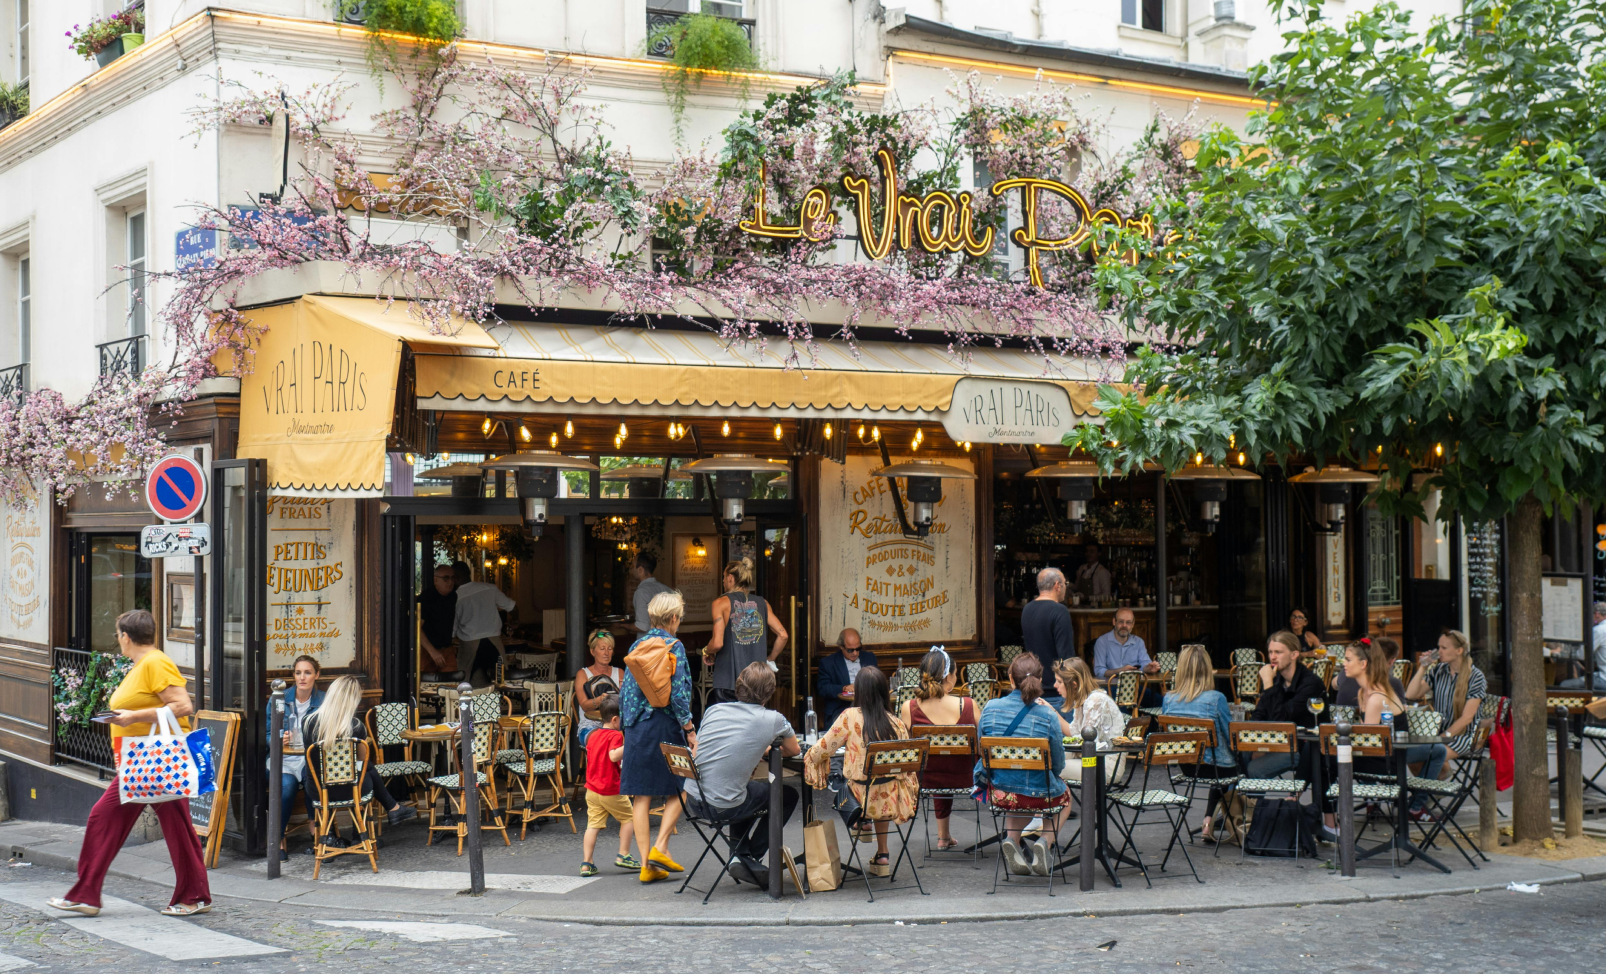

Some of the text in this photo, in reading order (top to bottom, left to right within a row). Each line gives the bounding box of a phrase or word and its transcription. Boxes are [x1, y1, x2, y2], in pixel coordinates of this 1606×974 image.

[738, 159, 839, 243] Le
[841, 147, 995, 260] Vrai
[263, 340, 368, 415] VRAI PARIS
[493, 368, 541, 390] CAFÉ
[963, 387, 1061, 427] VRAI PARIS
[286, 417, 335, 438] Montmartre
[988, 426, 1036, 438] Montmartre
[279, 506, 322, 520] FRAIS
[273, 541, 327, 561] PETITS
[866, 548, 936, 569] PRODUITS FRAIS
[266, 561, 344, 595] ÉJEUNERS
[866, 575, 935, 598] FAIT MAISON
[863, 598, 906, 616] TOUTE
[909, 589, 950, 615] HEURE
[274, 616, 328, 631] DESSERTS
